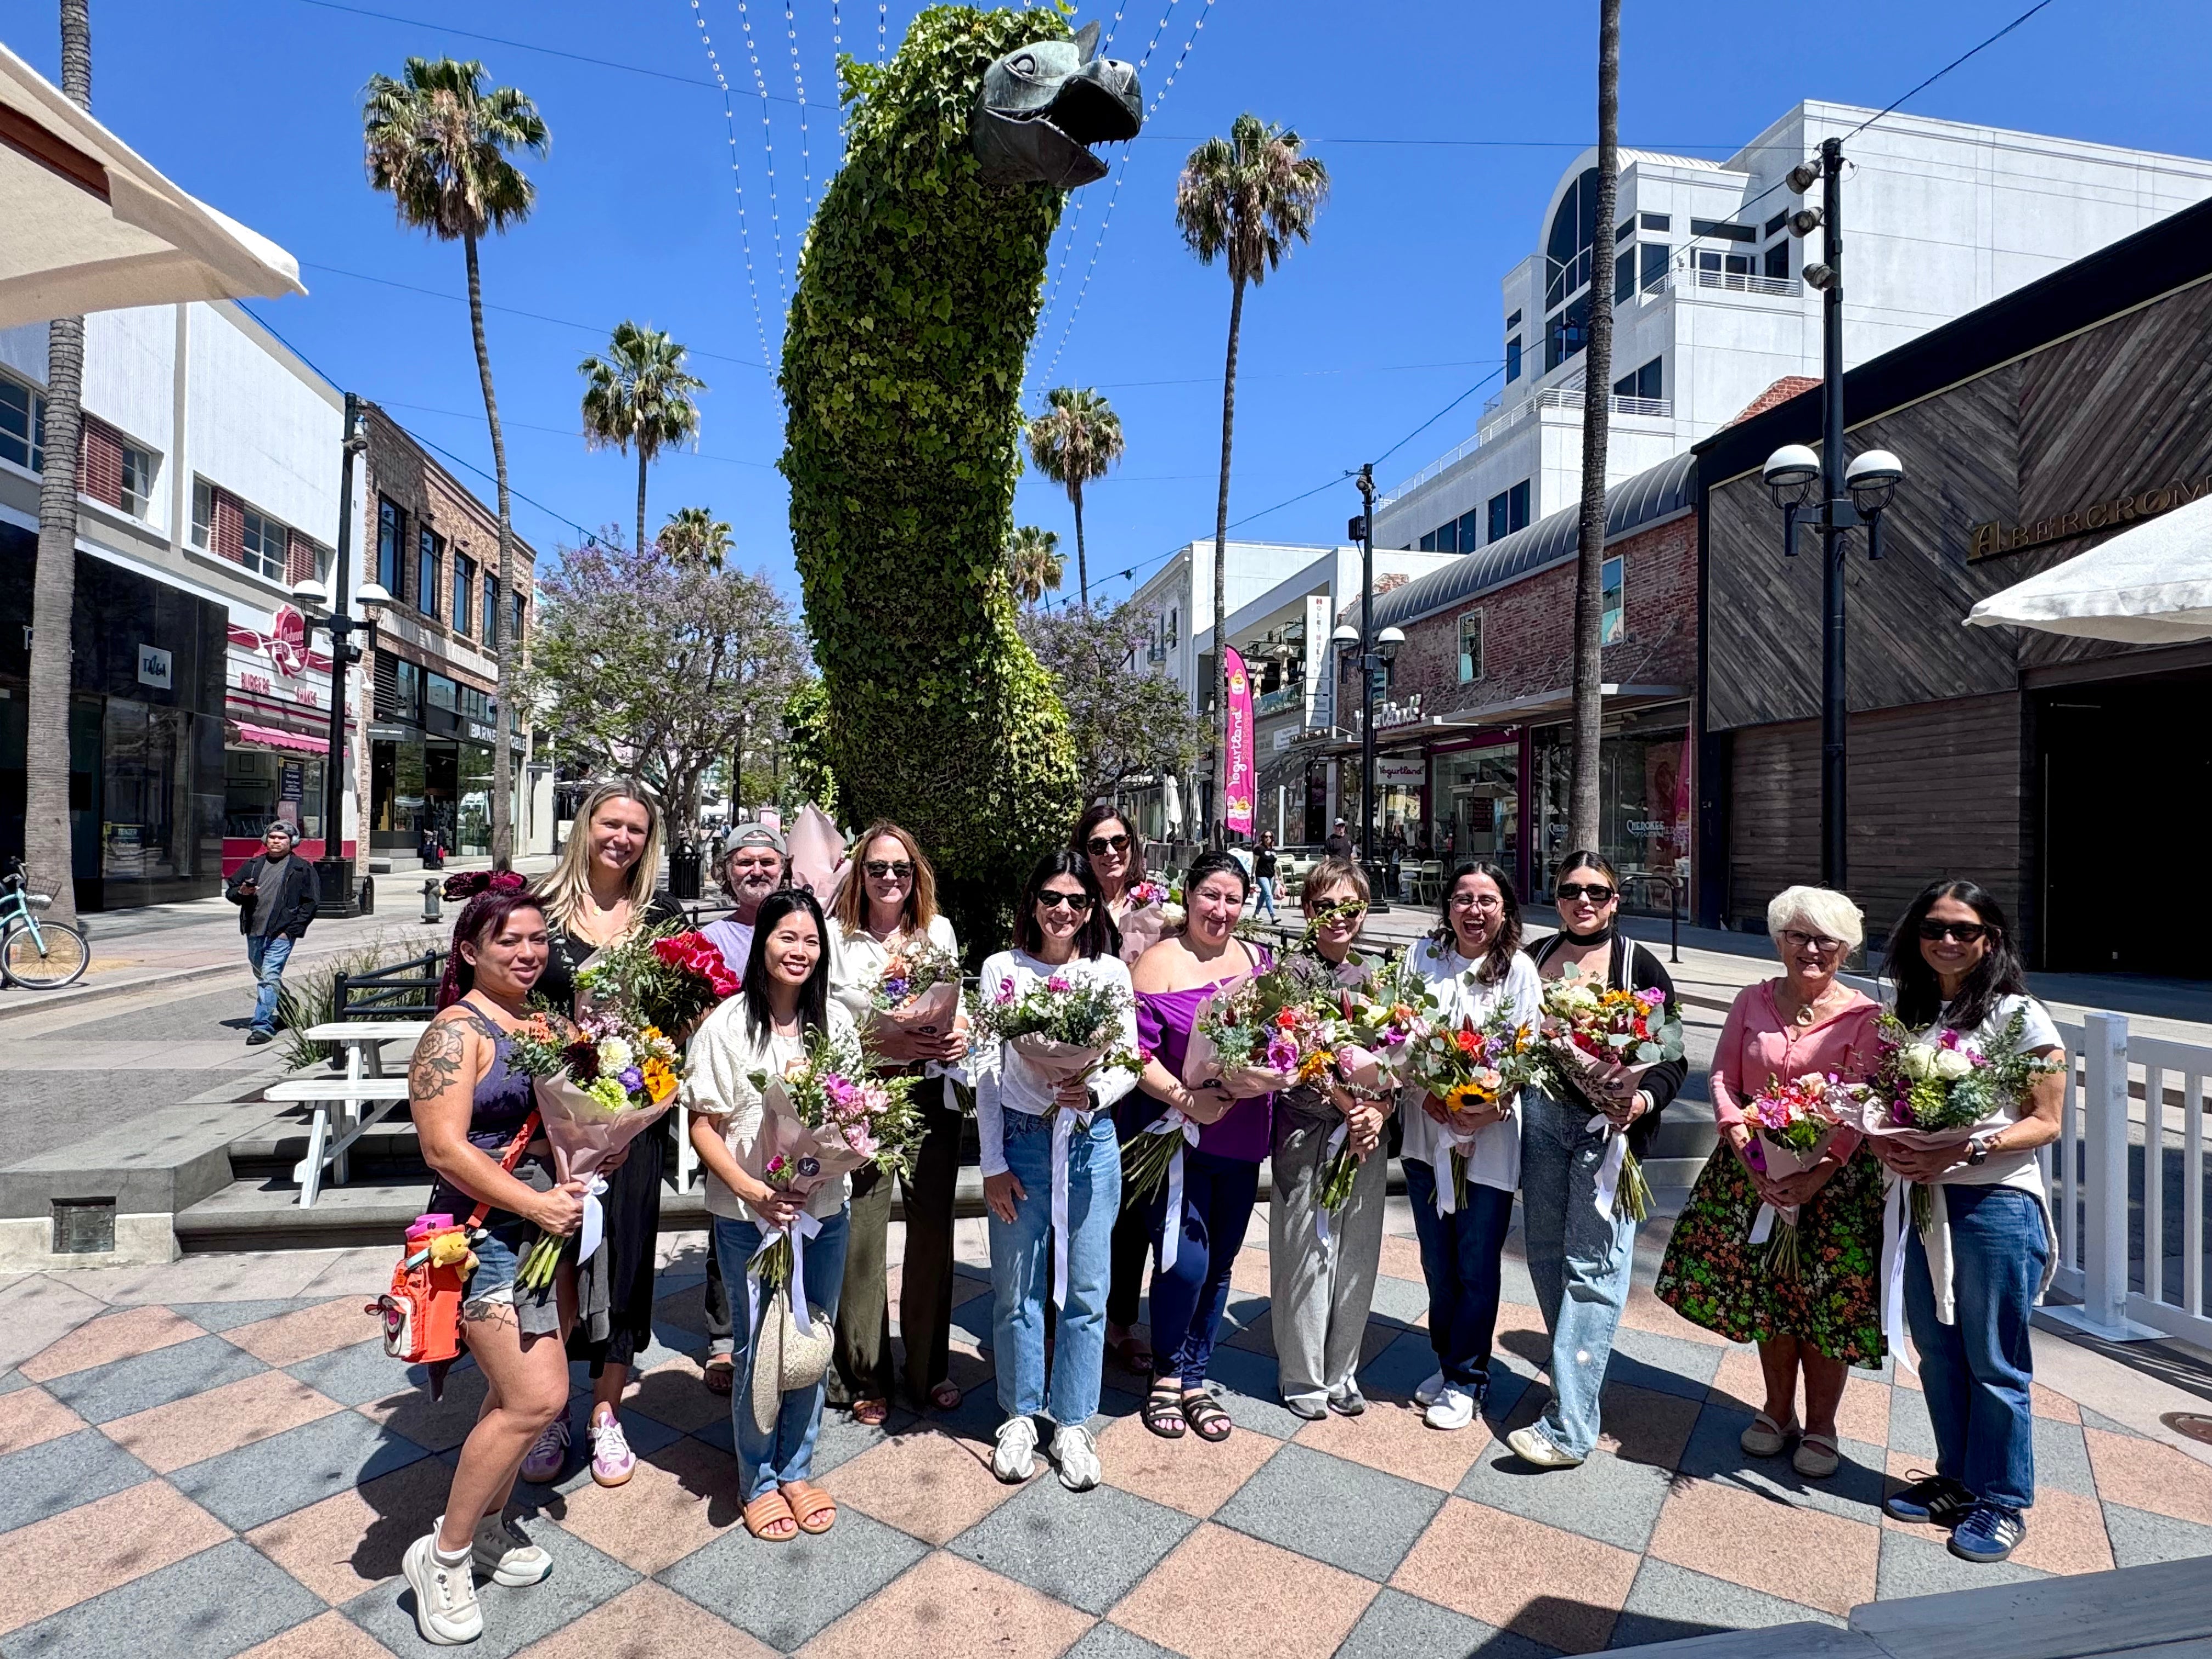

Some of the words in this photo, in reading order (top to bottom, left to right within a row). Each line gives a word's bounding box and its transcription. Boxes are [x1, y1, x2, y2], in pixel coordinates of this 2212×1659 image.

[469, 723, 497, 743] BARNE
[510, 735, 526, 752] OBLE
[1228, 707, 1247, 787] Yogurtland
[1378, 765, 1425, 779] Yogurtland
